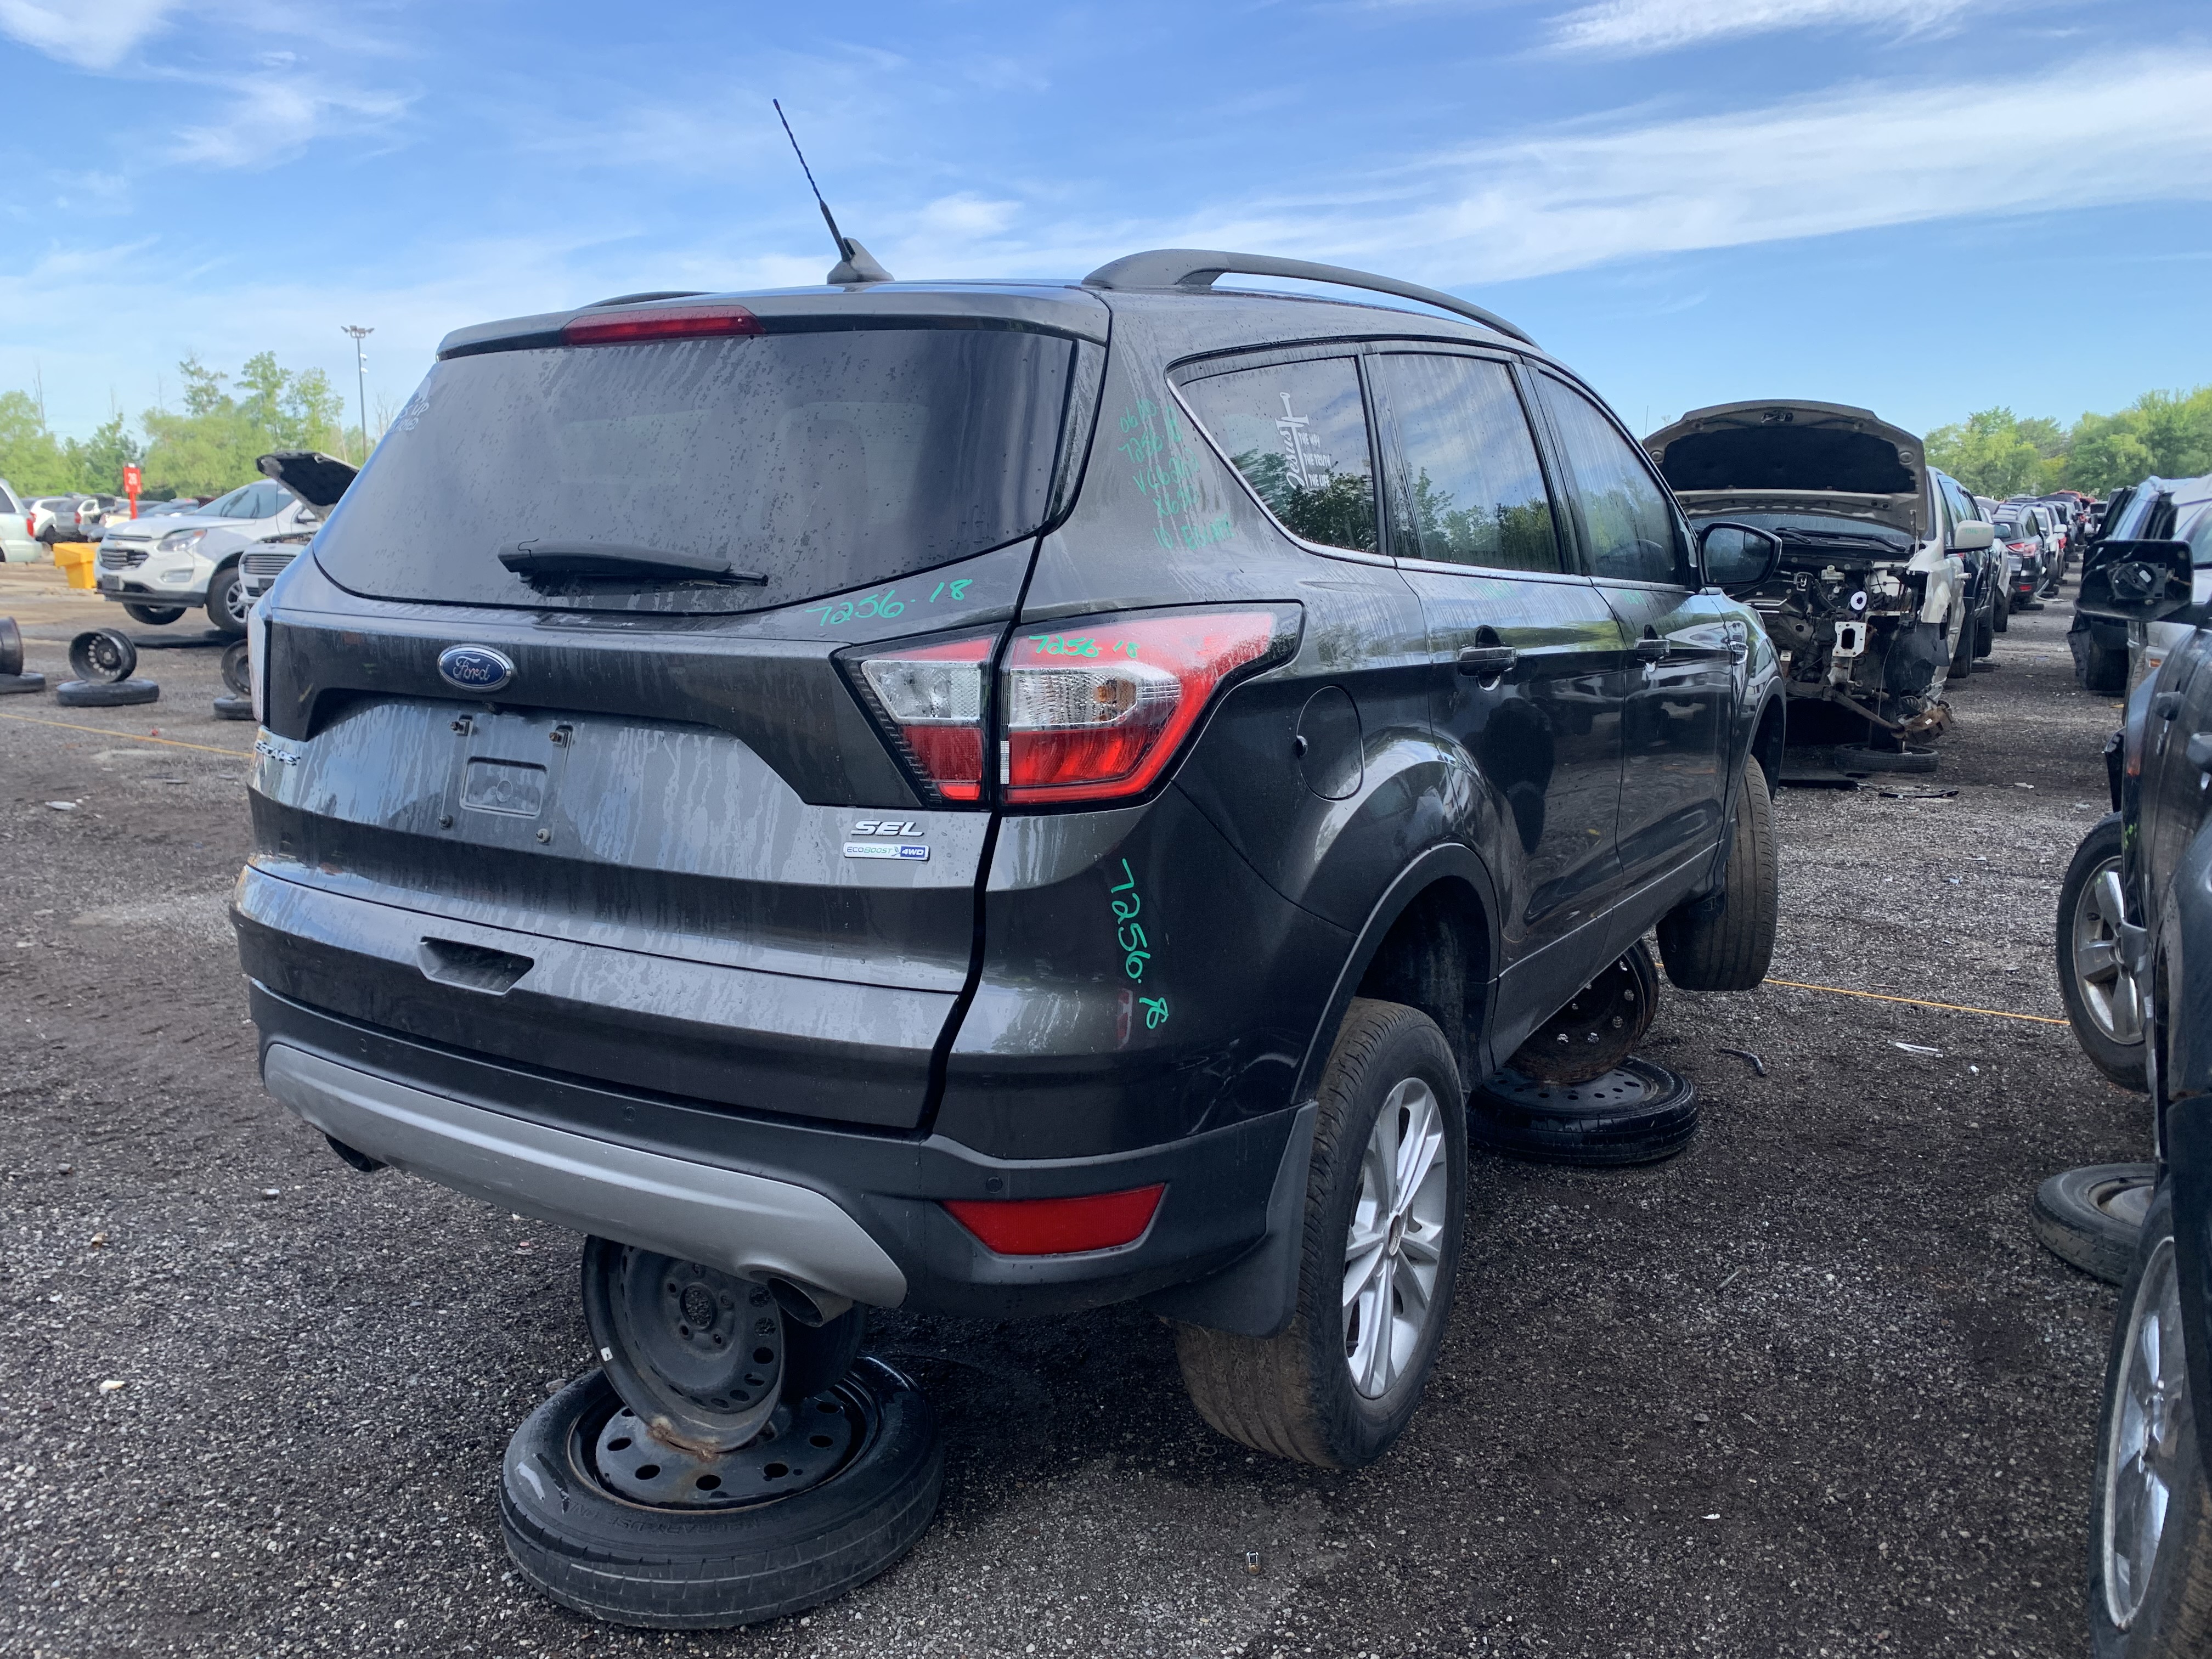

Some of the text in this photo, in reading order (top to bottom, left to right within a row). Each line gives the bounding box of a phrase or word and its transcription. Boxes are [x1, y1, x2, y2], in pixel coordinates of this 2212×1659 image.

[1298, 432, 1320, 448] THE WAY
[1279, 430, 1305, 489] Jesus
[1303, 453, 1331, 467] THE TRUTH
[1308, 473, 1330, 487] THE LIFE
[453, 656, 490, 680] Ford
[850, 821, 924, 837] SEL
